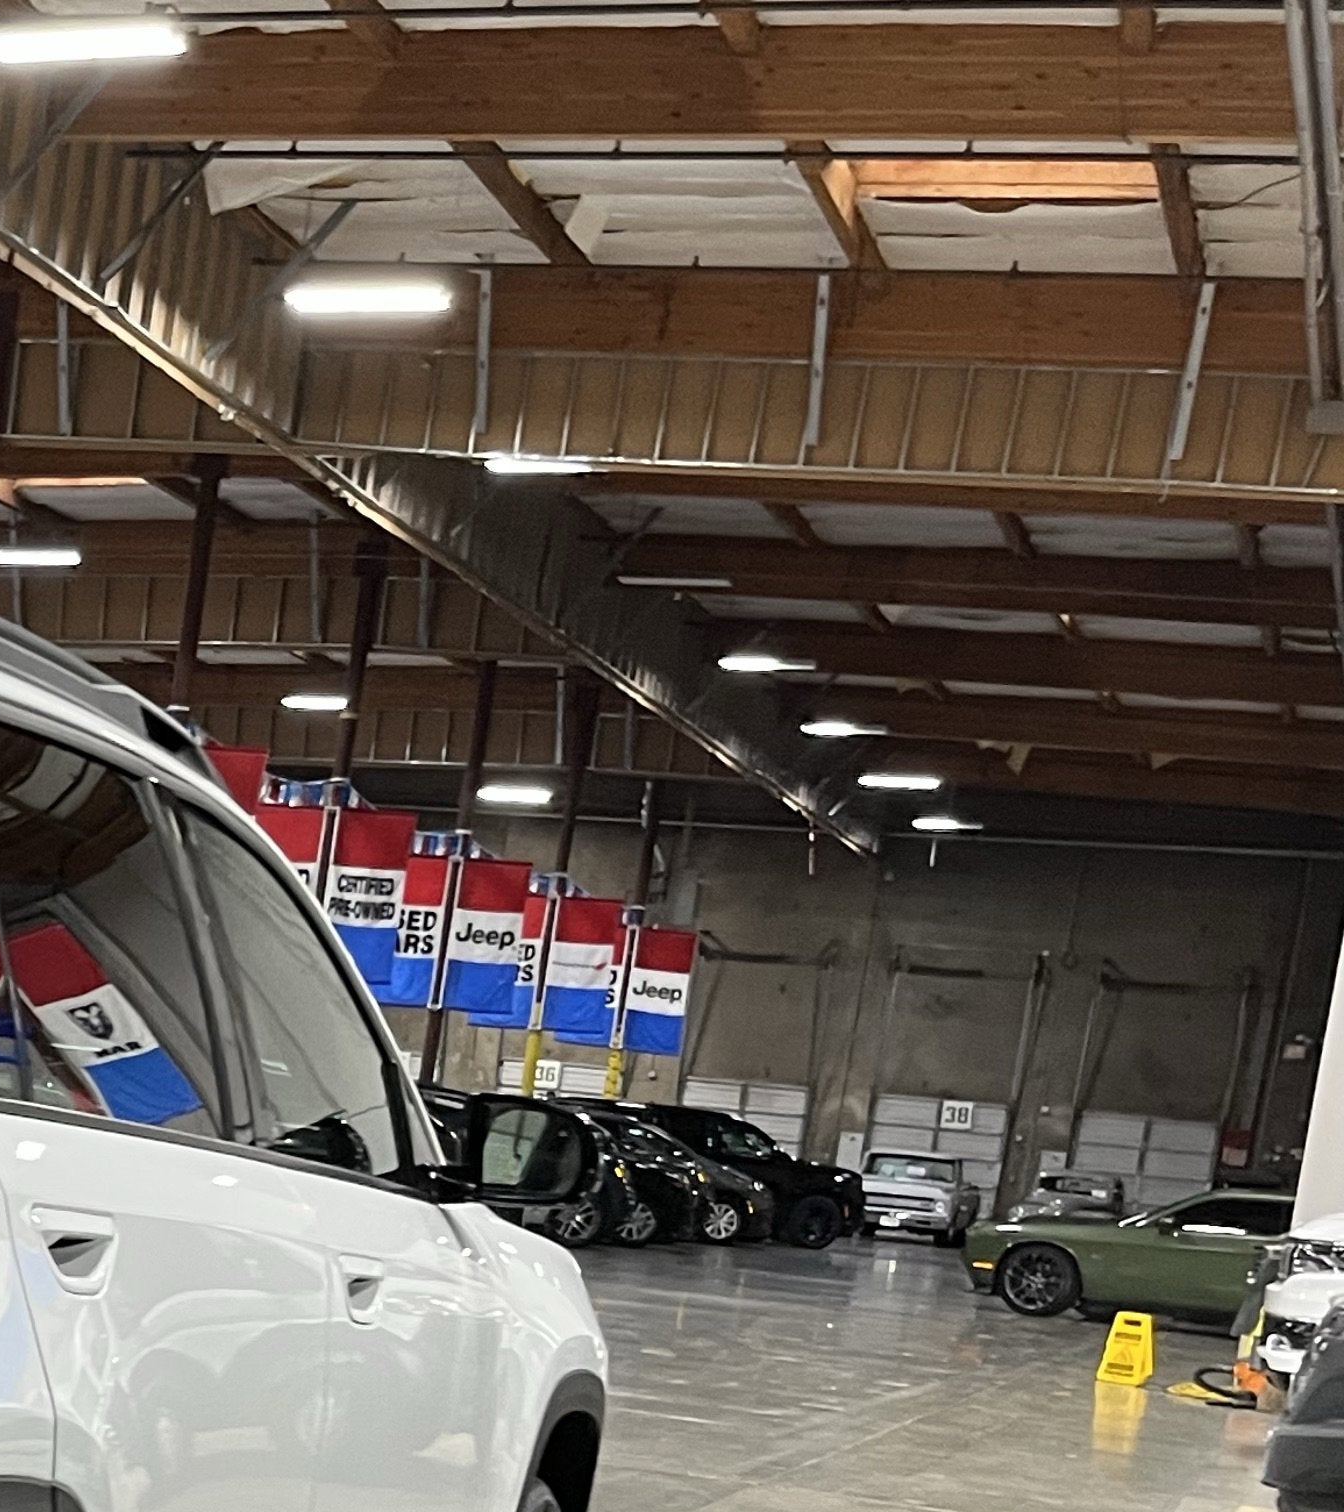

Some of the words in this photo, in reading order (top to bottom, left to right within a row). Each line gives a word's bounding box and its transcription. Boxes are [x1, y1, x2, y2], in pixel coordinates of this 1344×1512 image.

[456, 922, 516, 950] Jeep
[632, 980, 683, 1003] Jeep
[944, 1106, 970, 1124] 38
